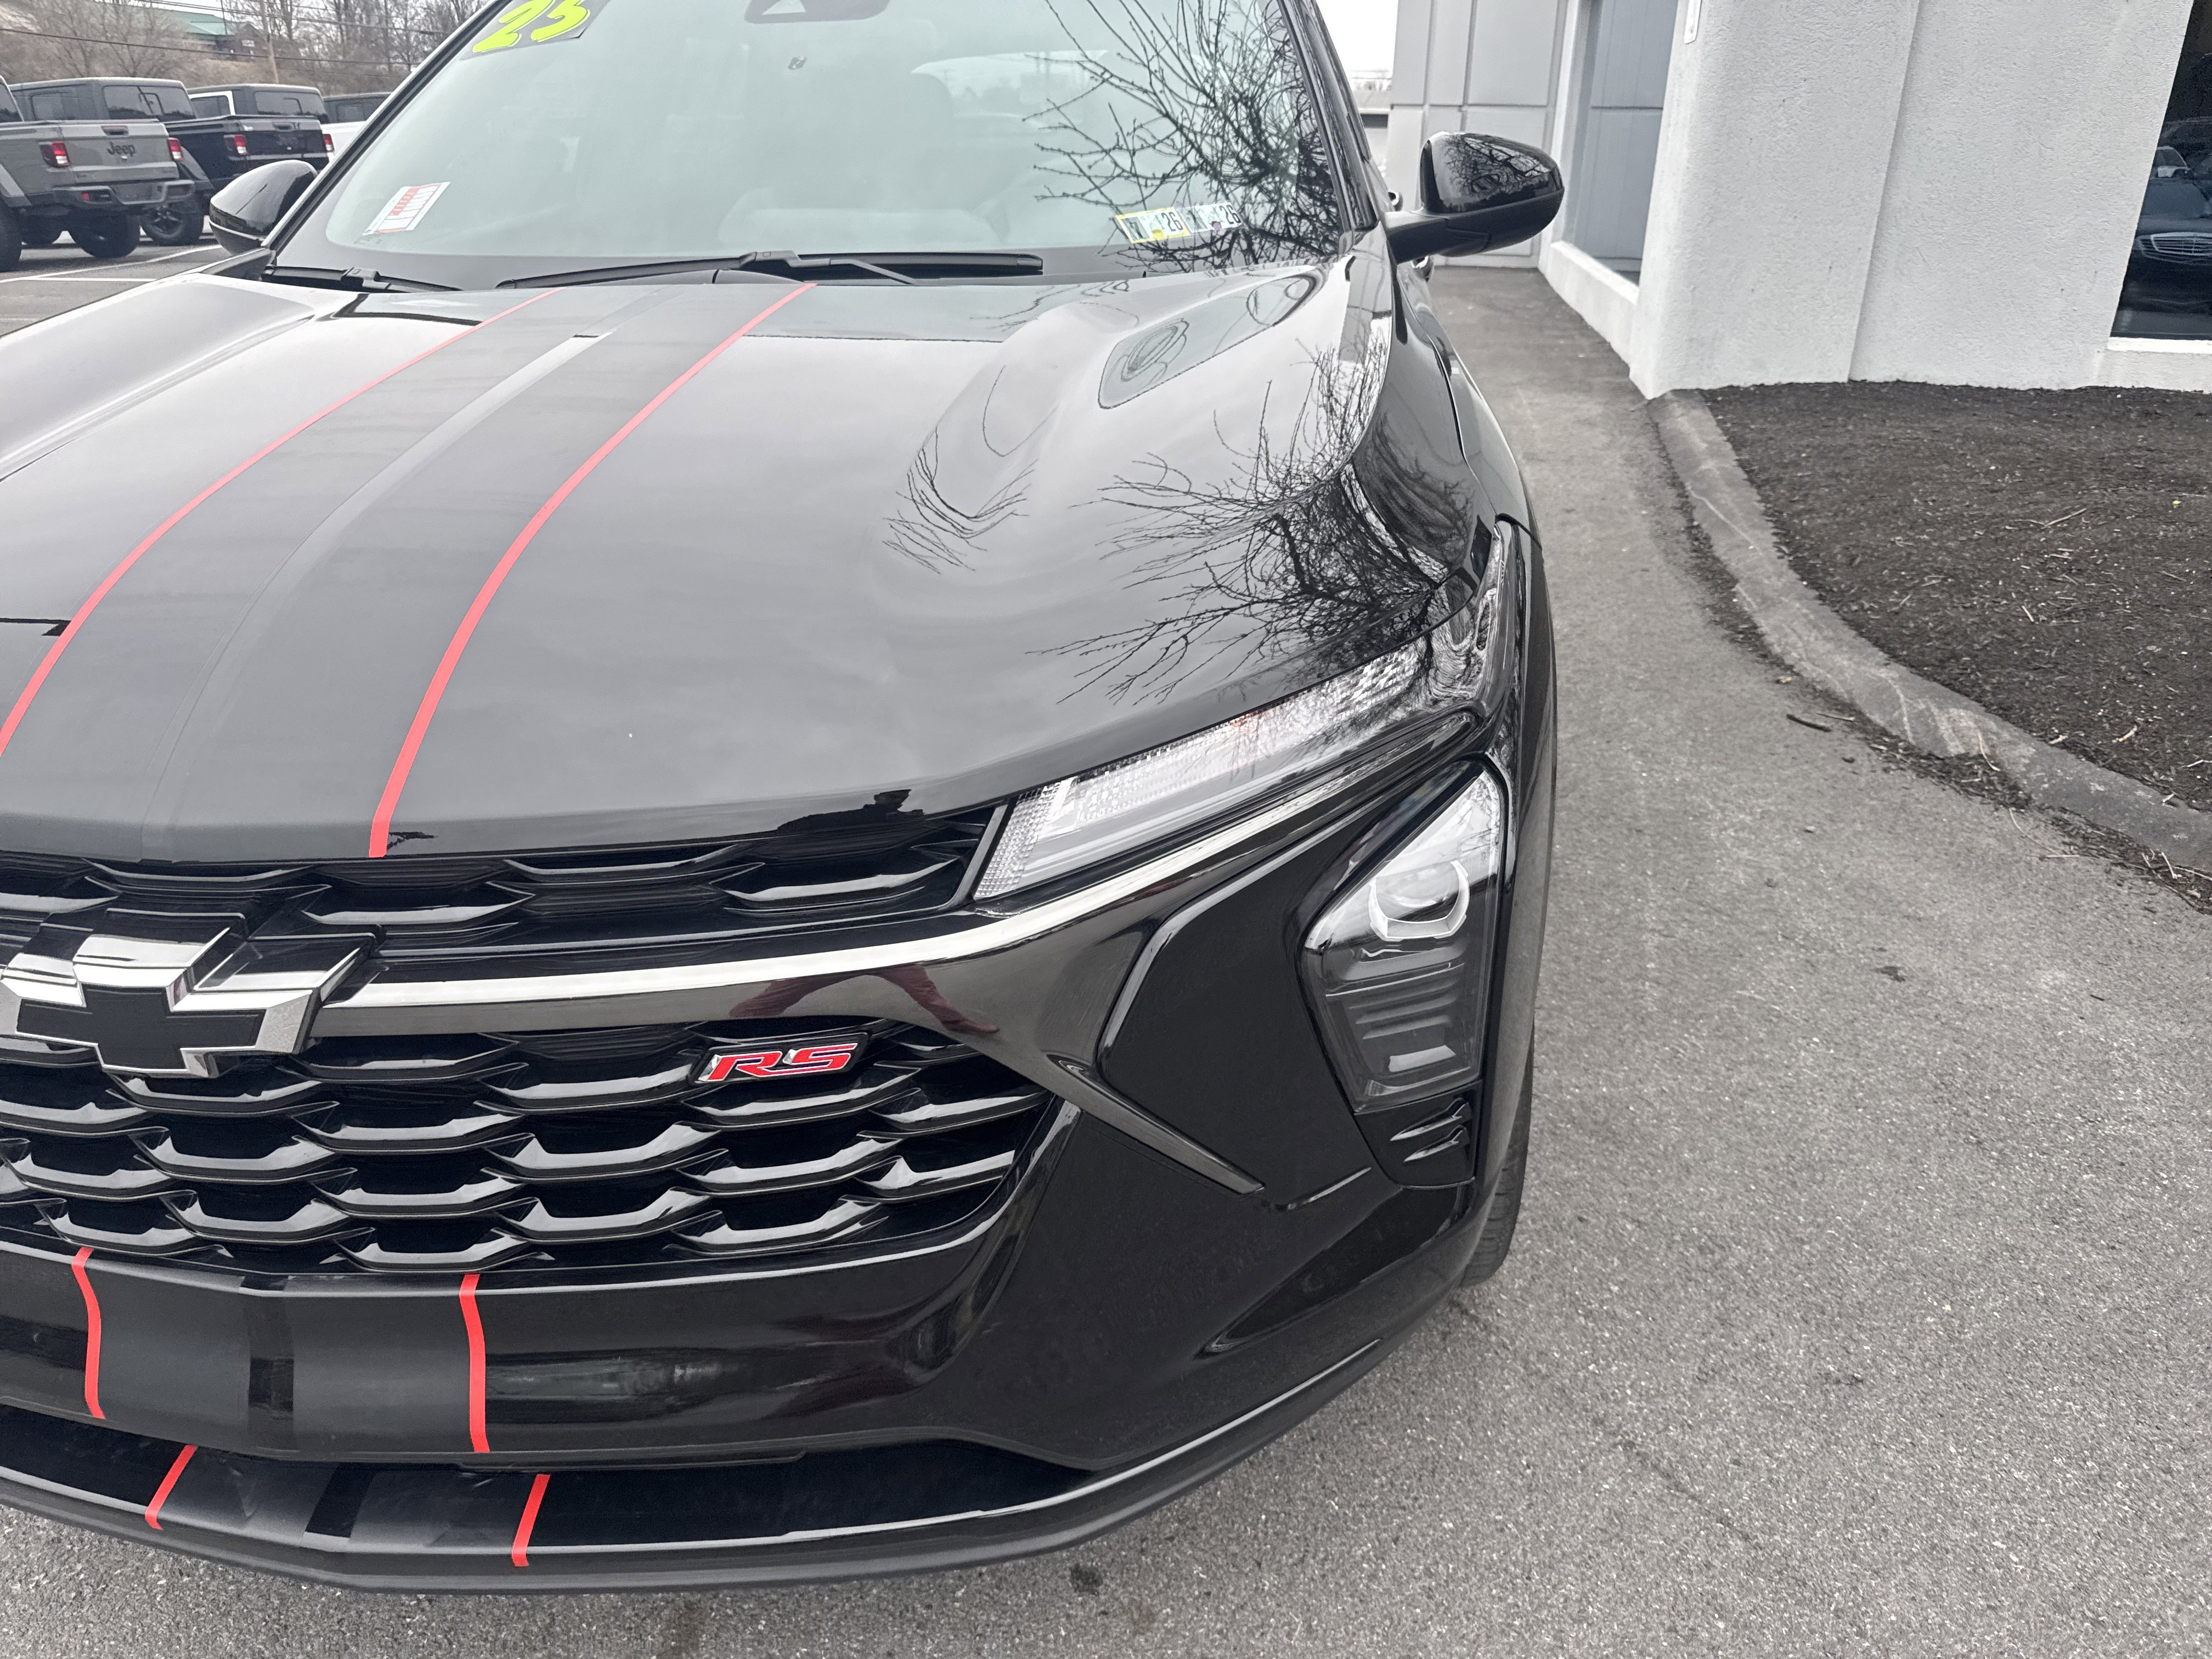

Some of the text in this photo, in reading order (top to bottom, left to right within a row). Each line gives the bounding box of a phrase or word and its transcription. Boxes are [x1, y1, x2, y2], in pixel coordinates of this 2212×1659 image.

[106, 142, 136, 157] Jeep
[1161, 212, 1183, 232] 26
[1219, 205, 1242, 224] 26
[698, 1043, 858, 1082] RS
